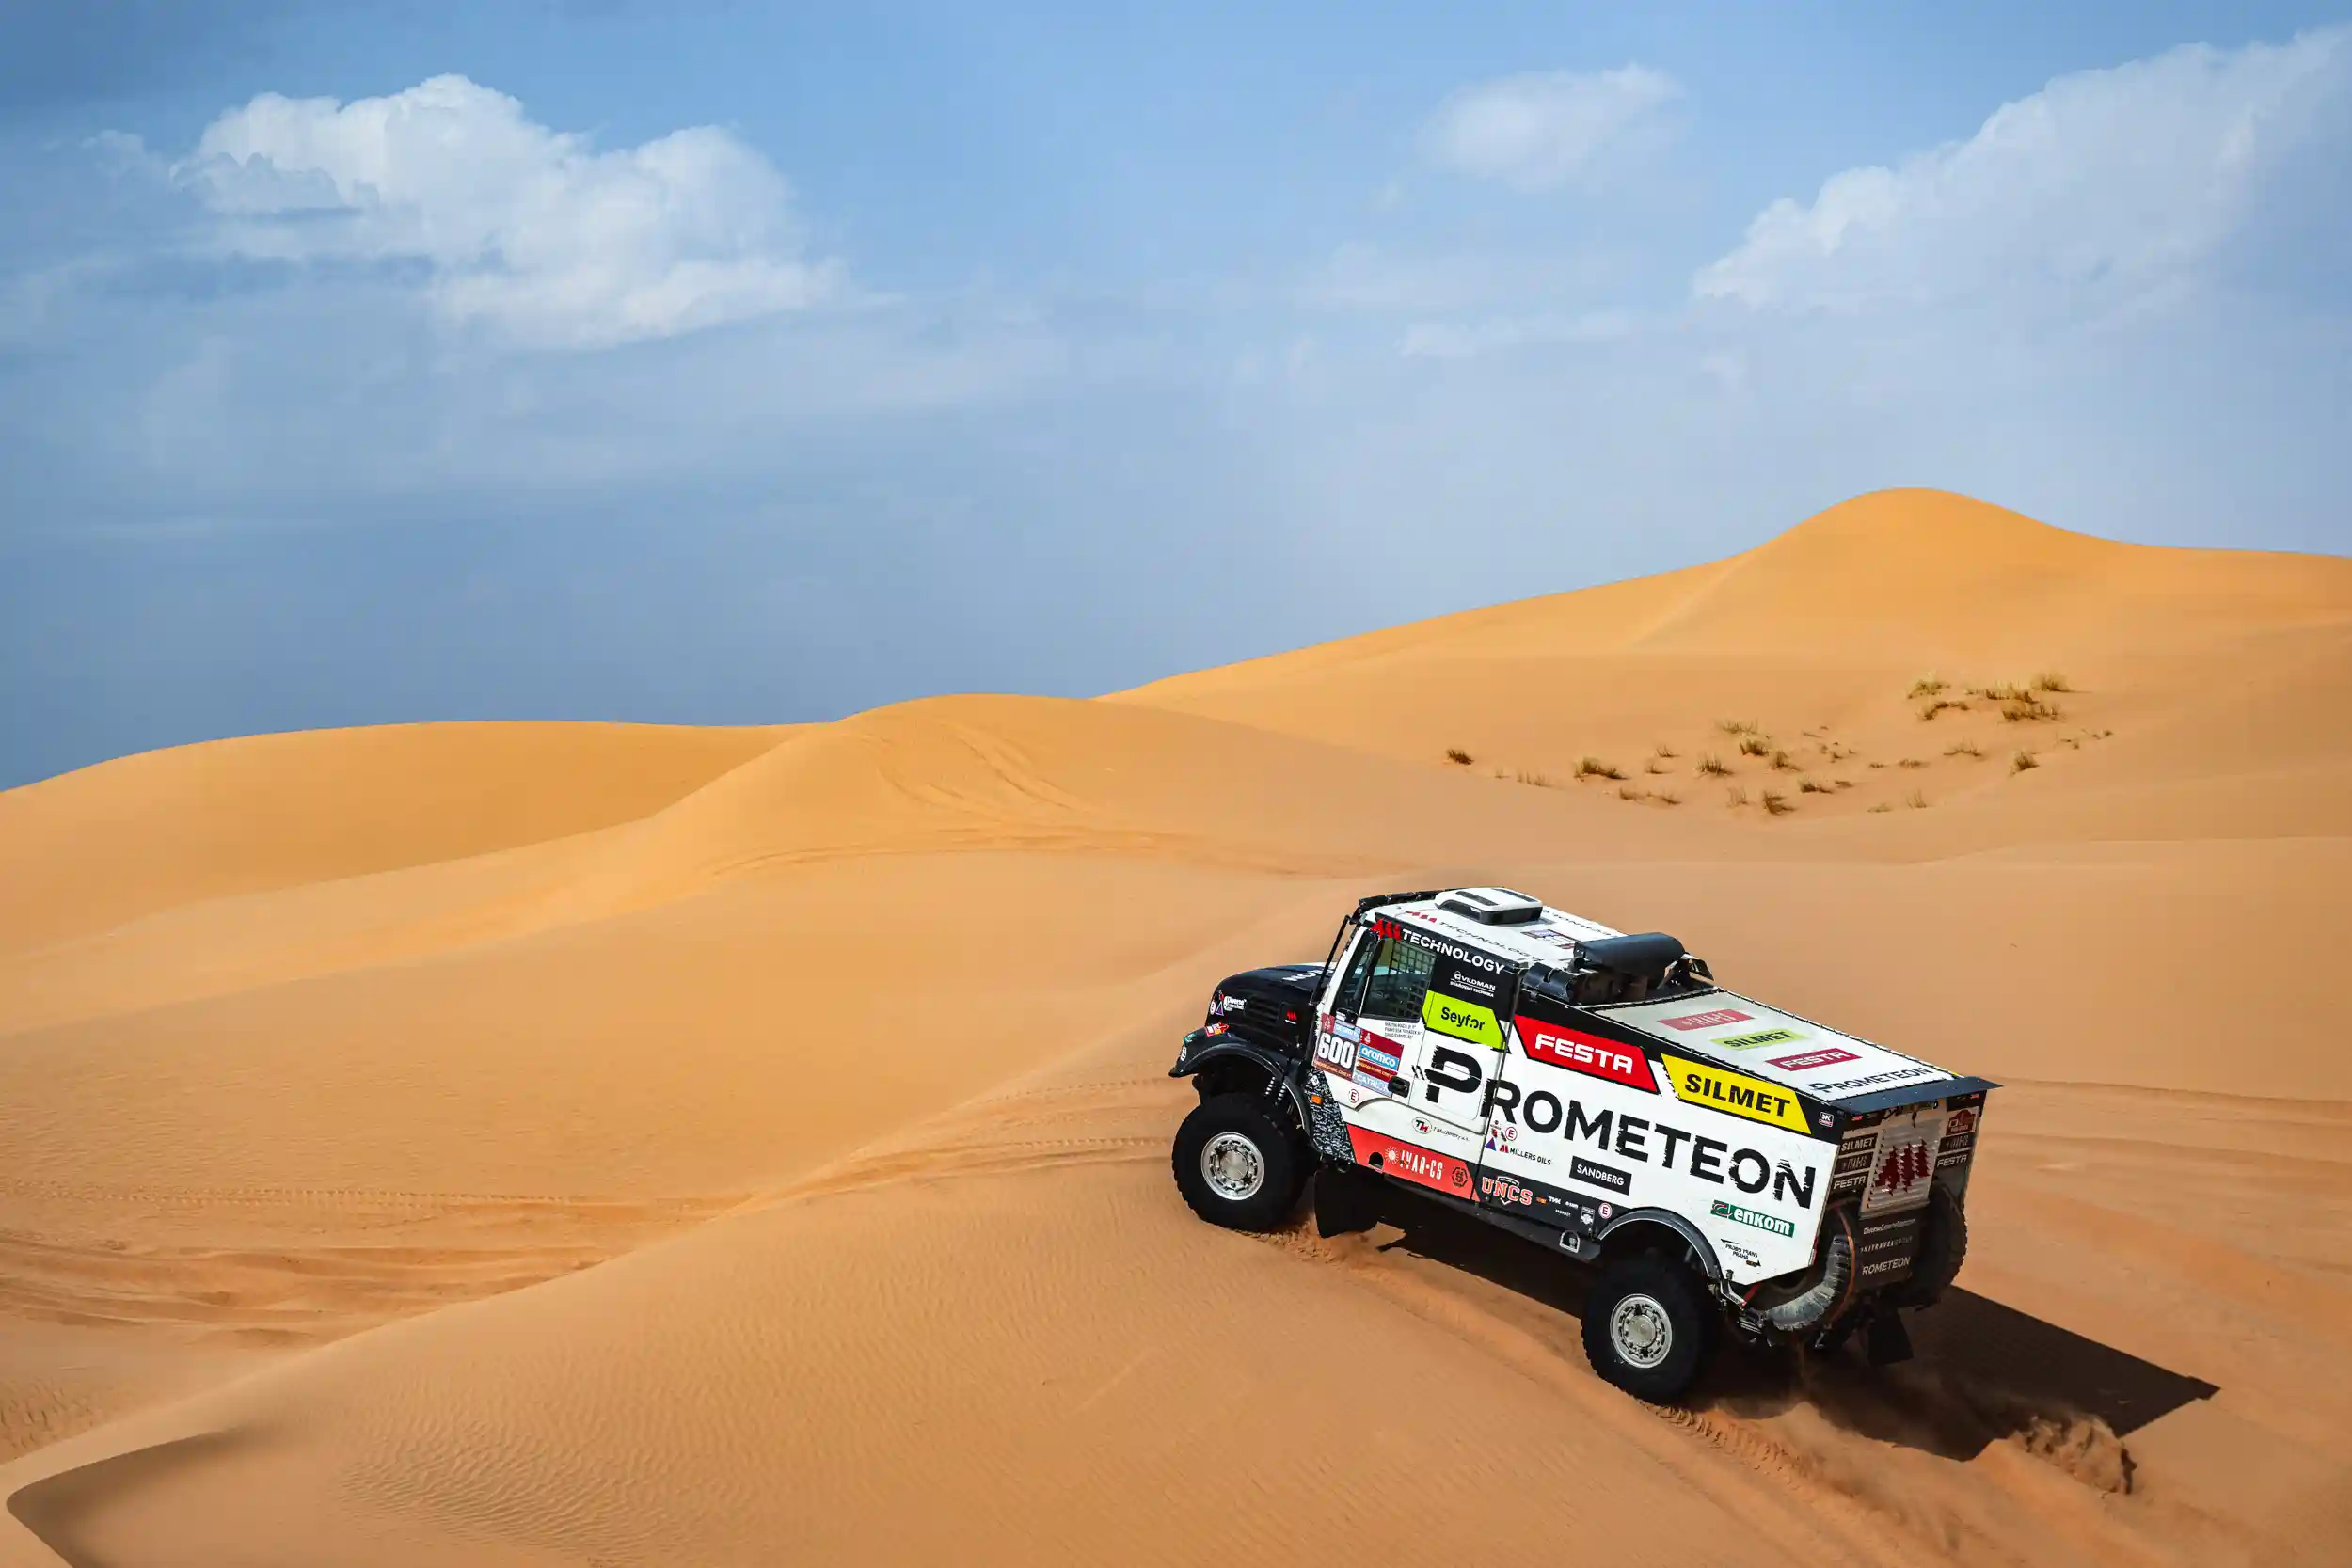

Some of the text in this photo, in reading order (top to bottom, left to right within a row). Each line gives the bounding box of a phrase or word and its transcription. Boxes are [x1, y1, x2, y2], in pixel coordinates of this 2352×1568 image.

[1402, 927, 1505, 974] TECHNOLOGY
[1318, 1032, 1355, 1069] 600
[1723, 1030, 1793, 1049] SILMET
[1361, 1045, 1396, 1068] aramco
[1534, 1033, 1633, 1074] FESTA
[1779, 1051, 1851, 1069] FESTA
[1806, 1066, 1935, 1093] PROMETEON
[1684, 1073, 1791, 1117] SILMET
[1413, 1044, 1818, 1210] PROMETEON
[1415, 1118, 1430, 1132] TM
[1841, 1137, 1875, 1152] SILMET
[1509, 1147, 1551, 1166] MILLERS OILS
[1936, 1153, 1968, 1168] FESTA
[1576, 1164, 1625, 1186] SANDBERG
[1834, 1176, 1867, 1190] FESTA
[1481, 1177, 1534, 1206] UNCS
[1733, 1208, 1790, 1236] enkom
[1862, 1256, 1912, 1276] ROMETEON
